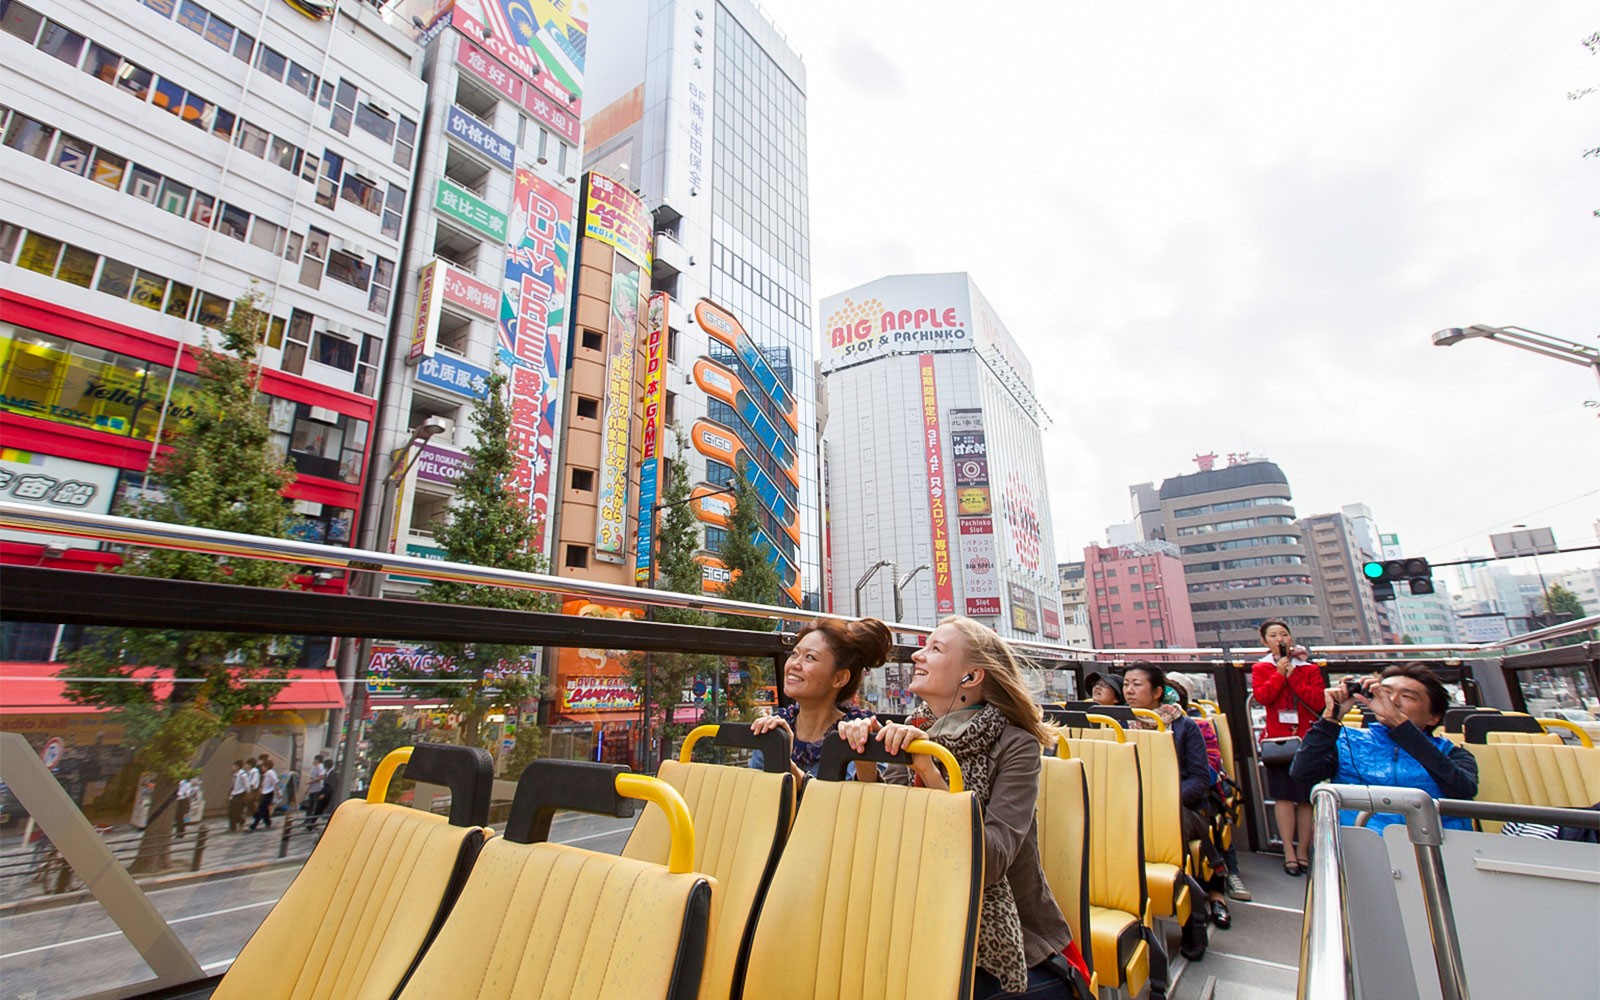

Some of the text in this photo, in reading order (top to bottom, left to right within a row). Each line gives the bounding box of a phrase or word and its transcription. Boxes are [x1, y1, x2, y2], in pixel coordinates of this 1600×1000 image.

[451, 114, 512, 163] 价格优惠
[440, 187, 505, 234] 货比三家
[587, 224, 614, 240] MEDIA
[832, 319, 872, 348] BIG
[845, 329, 966, 356] SLOT & PACHINKO
[422, 359, 488, 393] 优质服务
[419, 461, 468, 480] WELCOM
[960, 519, 992, 527] Pachinko
[968, 606, 1000, 614] Pachinko
[976, 598, 990, 606] Slot
